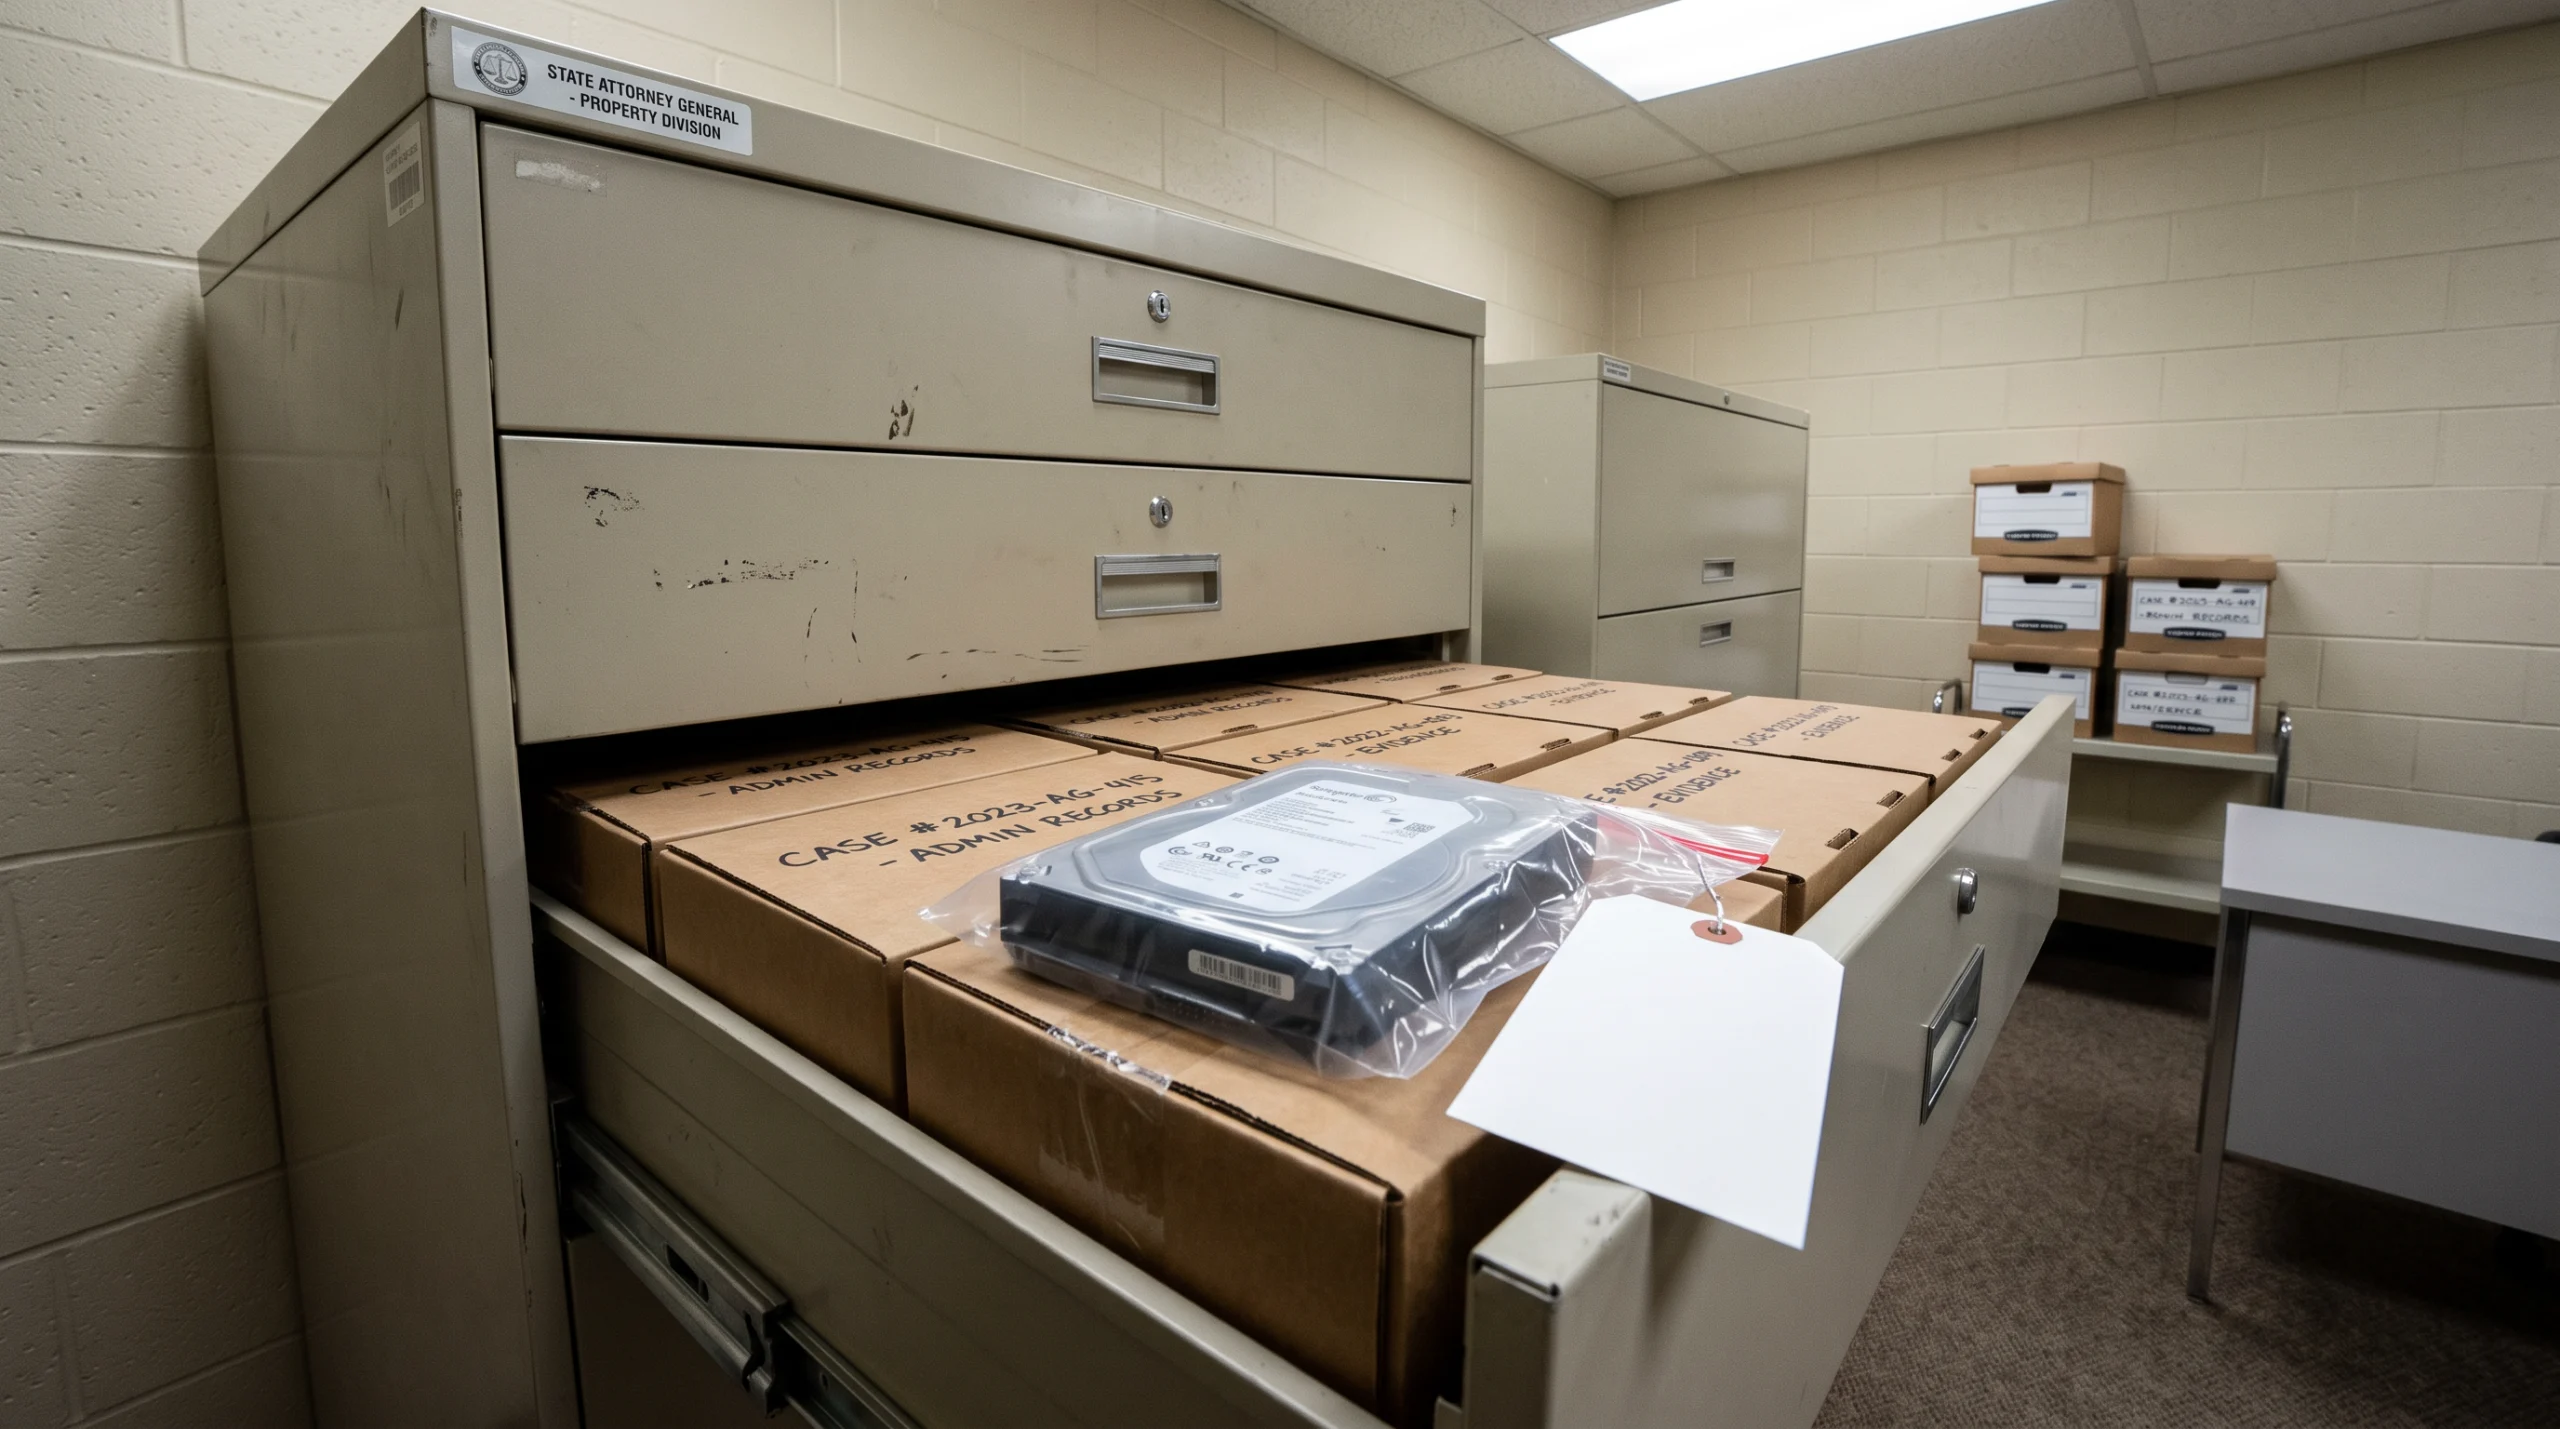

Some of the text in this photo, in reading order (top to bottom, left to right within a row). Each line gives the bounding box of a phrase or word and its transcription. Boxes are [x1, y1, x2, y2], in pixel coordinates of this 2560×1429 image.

[547, 64, 594, 89] STATE
[598, 77, 674, 109] ATTORNEY
[678, 97, 740, 126] GENERAL
[580, 93, 658, 125] PROPERTY
[662, 113, 721, 141] DIVISION
[628, 733, 972, 796] CASE #2023-AG-415
[1251, 746, 1321, 765] CASE
[1355, 726, 1461, 756] EVIDENCE
[728, 769, 839, 796] ADMIN
[844, 746, 977, 773] RECORDS
[1652, 766, 1741, 804] EVIDENCE
[778, 772, 1164, 869] CASE #2023-AG-415
[909, 823, 1037, 863] ADMIN
[1039, 788, 1183, 828] RECORDS
